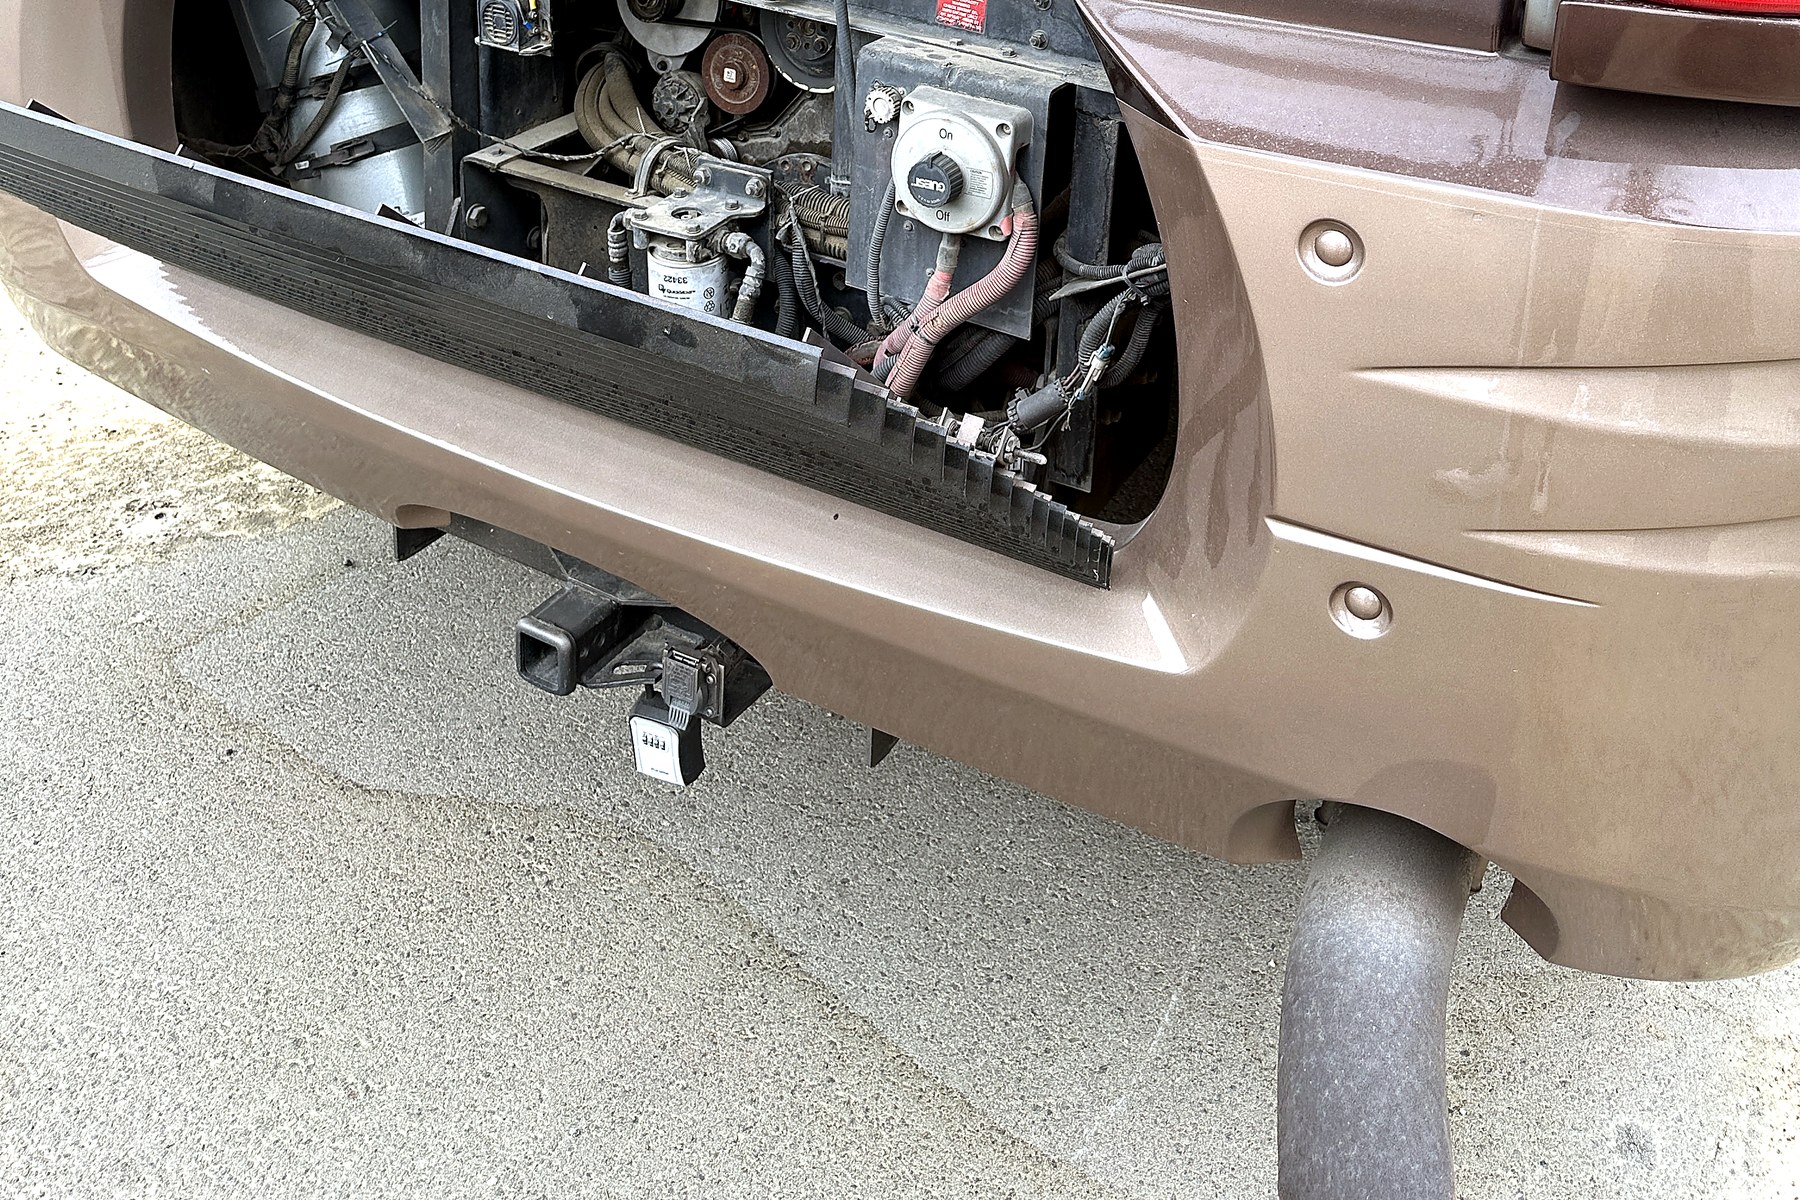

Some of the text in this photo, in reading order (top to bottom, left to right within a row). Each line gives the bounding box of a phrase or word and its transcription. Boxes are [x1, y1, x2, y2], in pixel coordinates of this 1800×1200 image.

[939, 128, 953, 140] On
[914, 177, 946, 193] GUEST
[936, 210, 950, 222] Off
[663, 275, 688, 284] 33422
